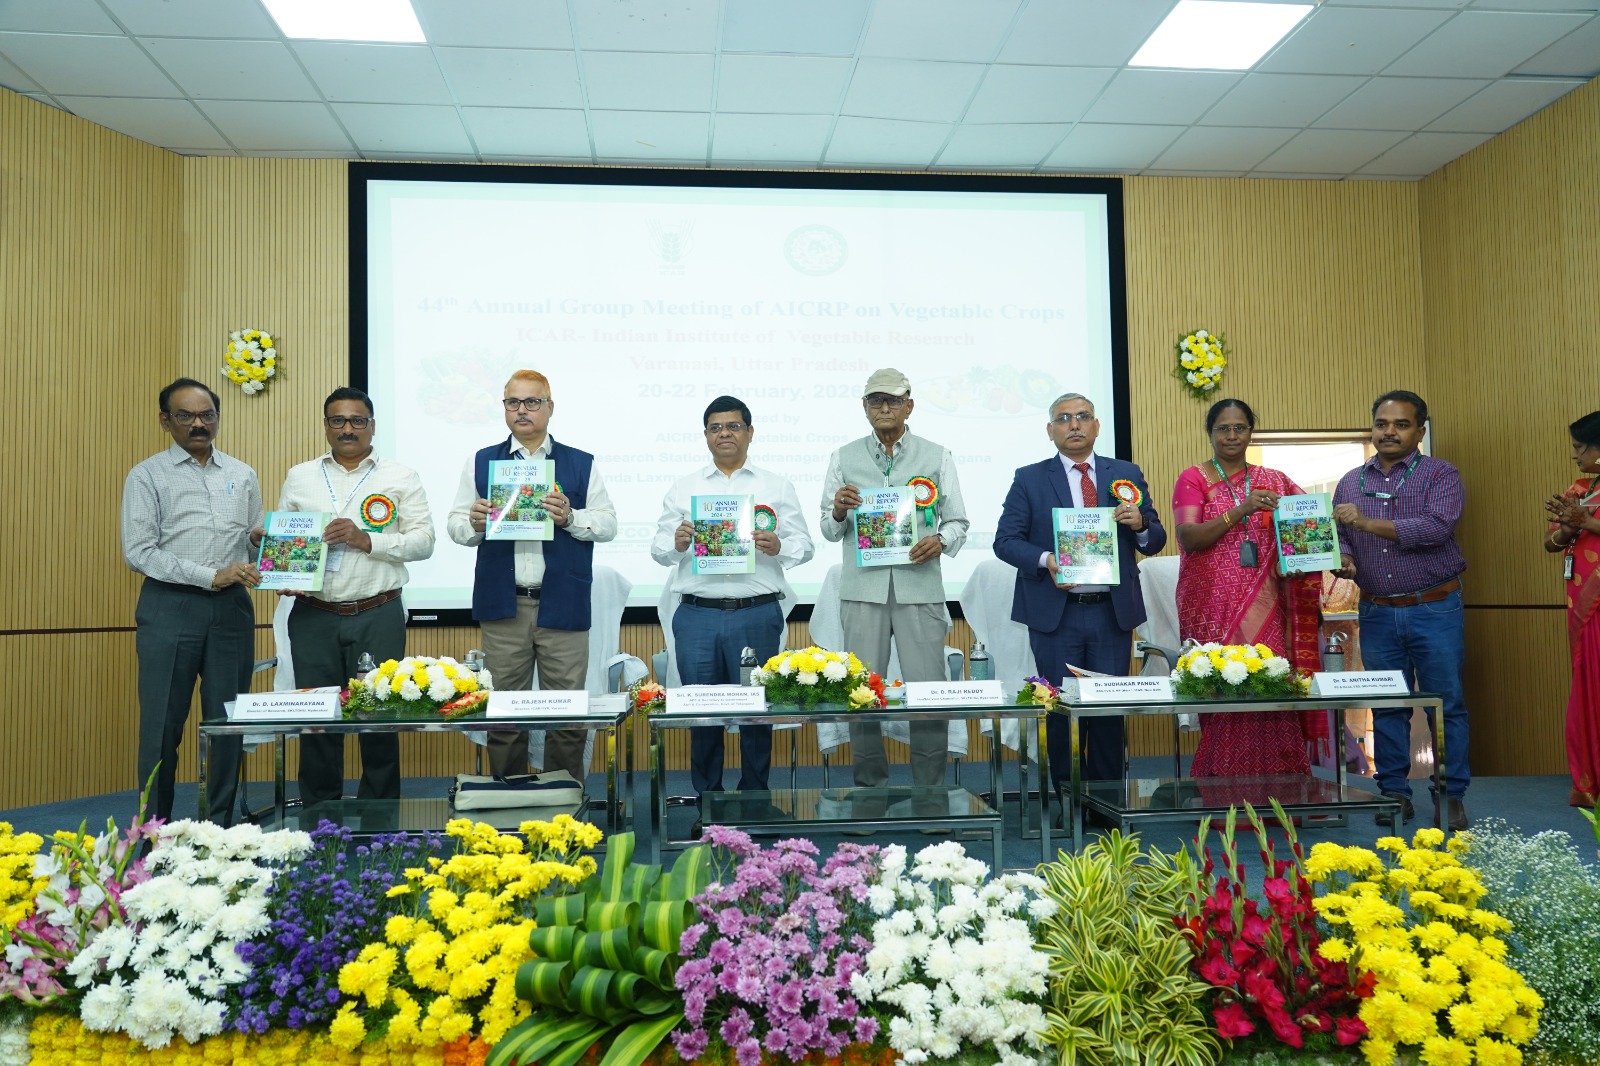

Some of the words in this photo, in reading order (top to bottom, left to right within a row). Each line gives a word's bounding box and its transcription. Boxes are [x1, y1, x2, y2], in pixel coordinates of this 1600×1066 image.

[416, 296, 458, 313] 44th
[467, 298, 552, 314] Annual
[560, 298, 634, 318] Group
[642, 299, 734, 319] Meeting
[741, 300, 764, 316] of
[769, 300, 849, 317] AICRP
[855, 305, 880, 317] on
[888, 302, 993, 320] Vegetable
[1000, 304, 1066, 324] Crops
[516, 327, 586, 343] ICAR-
[592, 328, 658, 344] Indian
[665, 329, 750, 344] Institute
[756, 330, 776, 344] of
[787, 330, 882, 347] Vegetable
[888, 331, 975, 346] Research
[630, 356, 724, 372] Varanasi,
[731, 356, 784, 372] Uttar
[791, 356, 870, 372] Pradesh
[638, 384, 696, 398] 20-22
[704, 384, 806, 401] February,
[813, 384, 862, 398] 2026
[784, 414, 800, 424] by
[656, 432, 703, 442] AICRP
[806, 432, 848, 444] Crops
[595, 452, 654, 462] esearch
